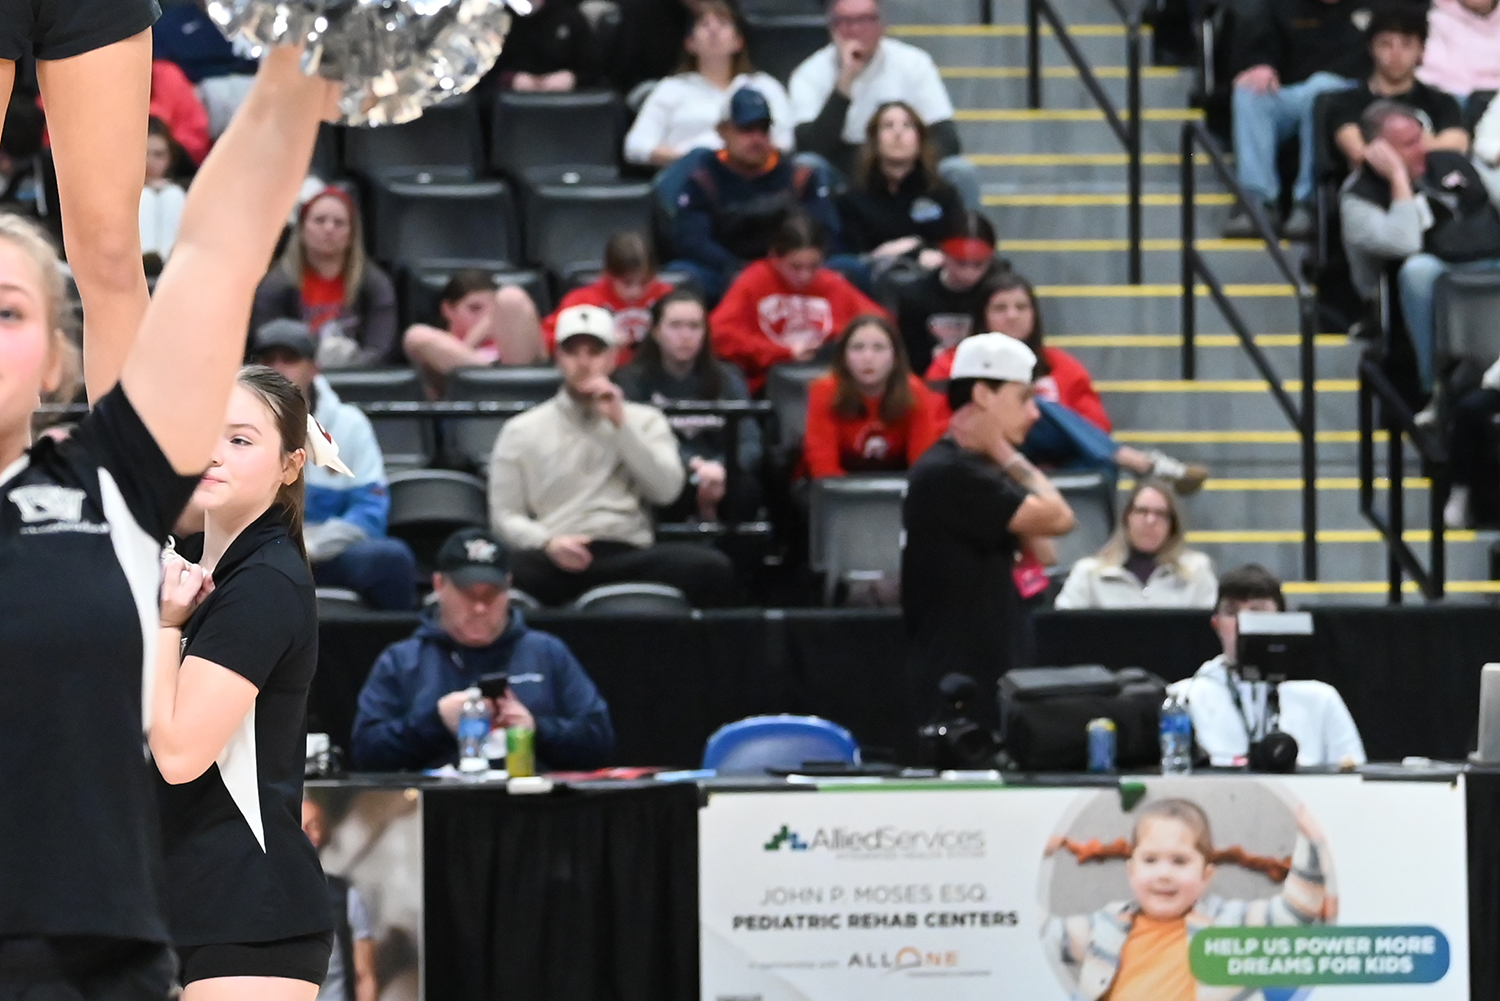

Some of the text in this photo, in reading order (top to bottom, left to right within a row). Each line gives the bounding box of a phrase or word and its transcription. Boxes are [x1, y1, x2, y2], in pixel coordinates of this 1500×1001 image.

[761, 886, 824, 906] JOHN
[854, 883, 933, 904] MOSES
[732, 910, 1019, 931] PEDIATRIC REHAB CENTERS
[1204, 935, 1437, 956] HELP US POWER MORE
[1227, 955, 1415, 976] DREAMS FOR KIDS
